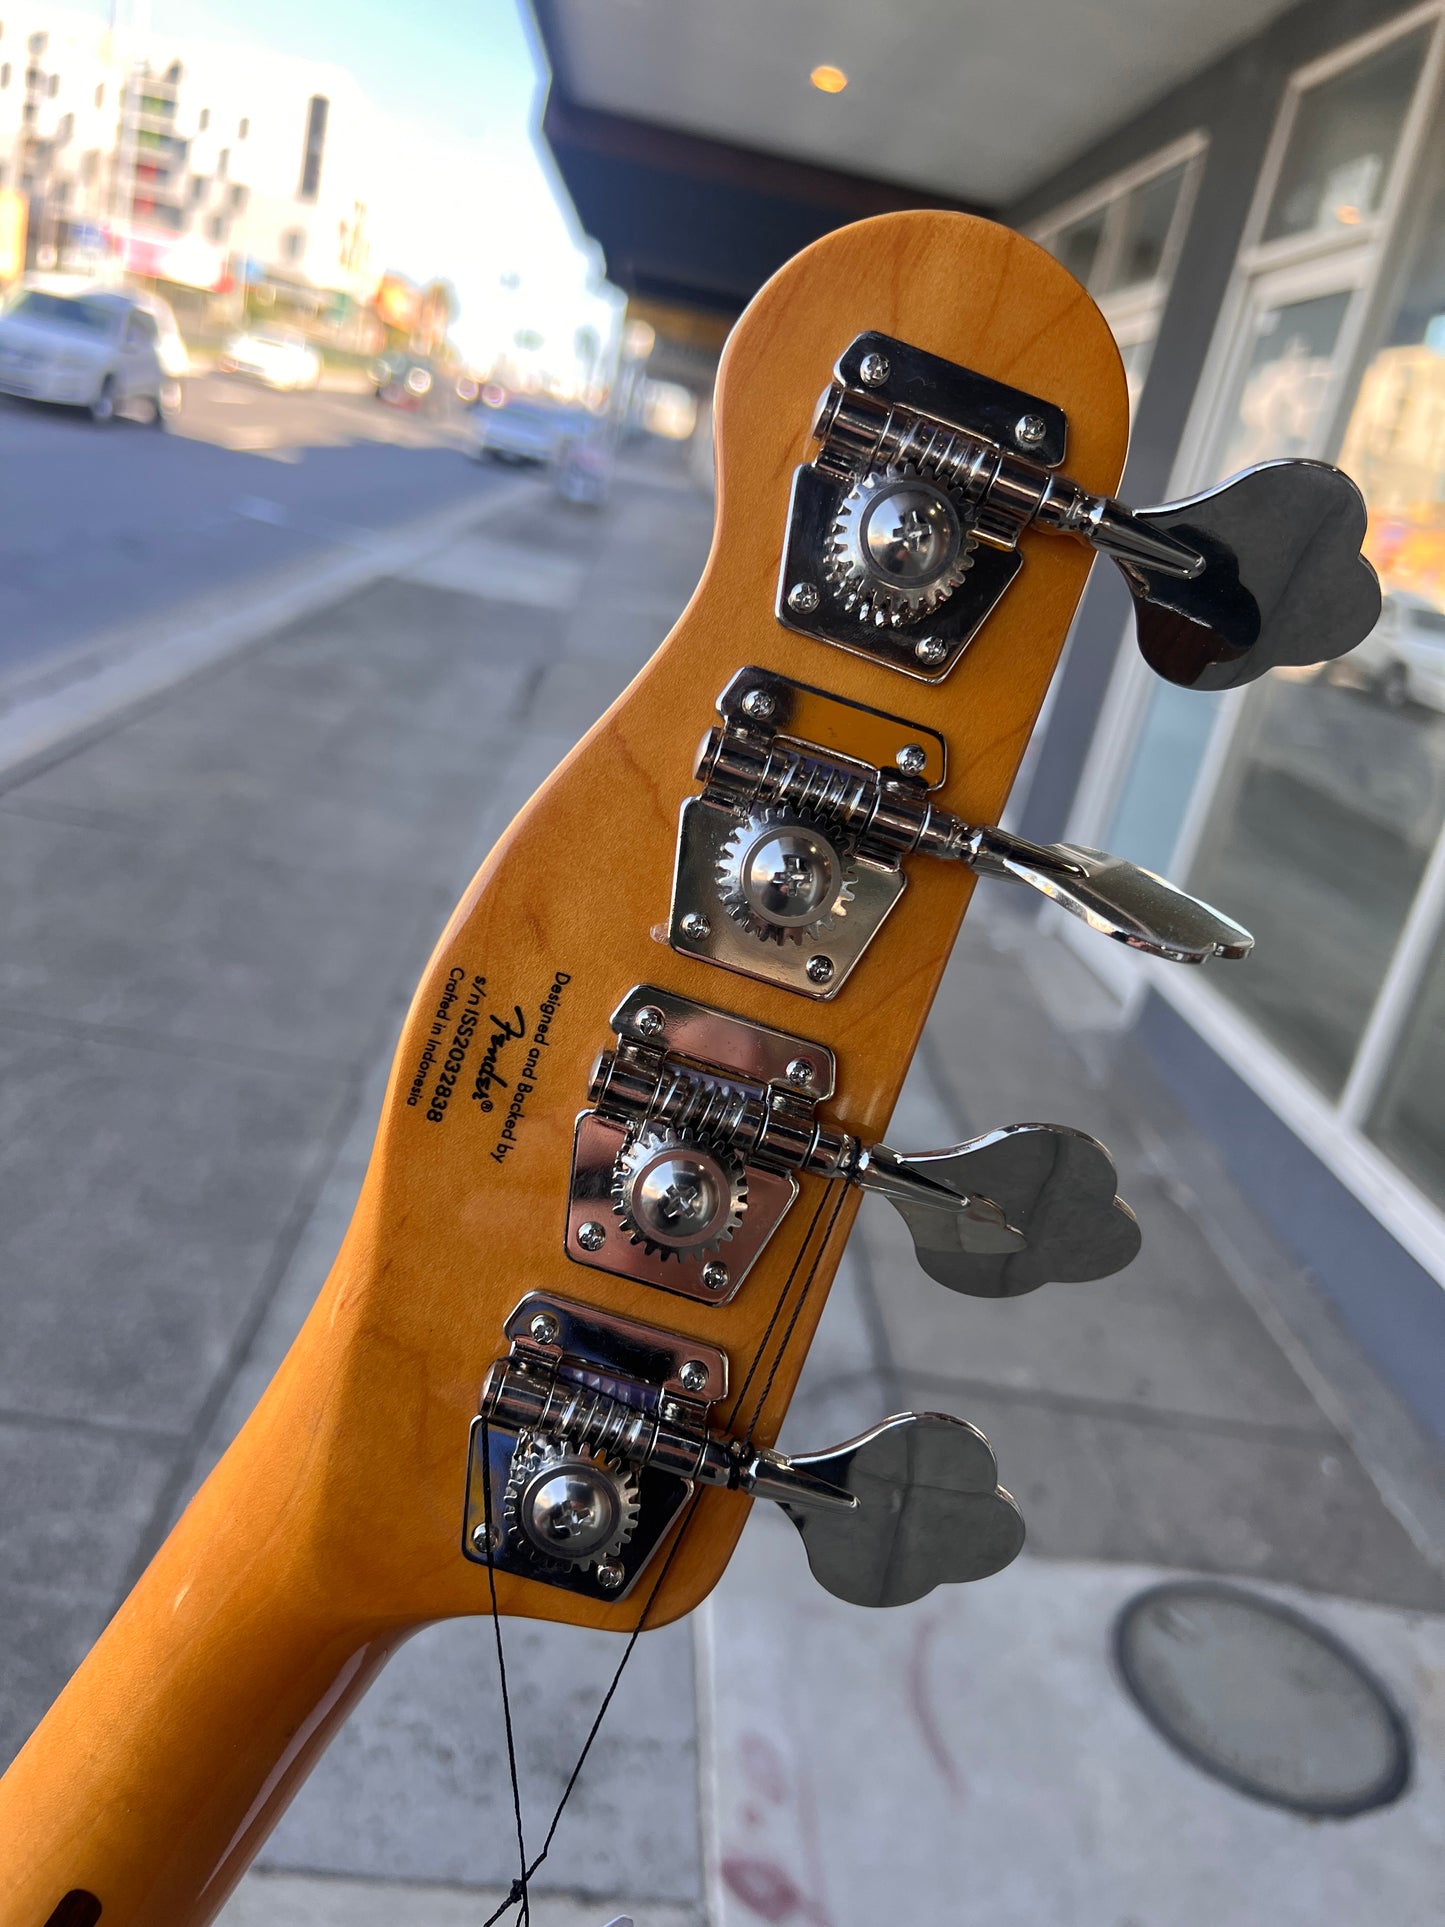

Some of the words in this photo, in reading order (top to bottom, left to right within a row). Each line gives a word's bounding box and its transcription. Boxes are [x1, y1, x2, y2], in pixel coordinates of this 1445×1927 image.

[436, 967, 464, 1021] Crafted
[467, 975, 487, 1006] s/n
[534, 971, 571, 1046] Designed
[431, 1022, 446, 1035] in
[407, 1038, 441, 1107] Indonesia
[426, 1008, 479, 1123] ISS2032838
[522, 1047, 540, 1080] and
[501, 1083, 533, 1141] Backed
[490, 1142, 514, 1164] by
